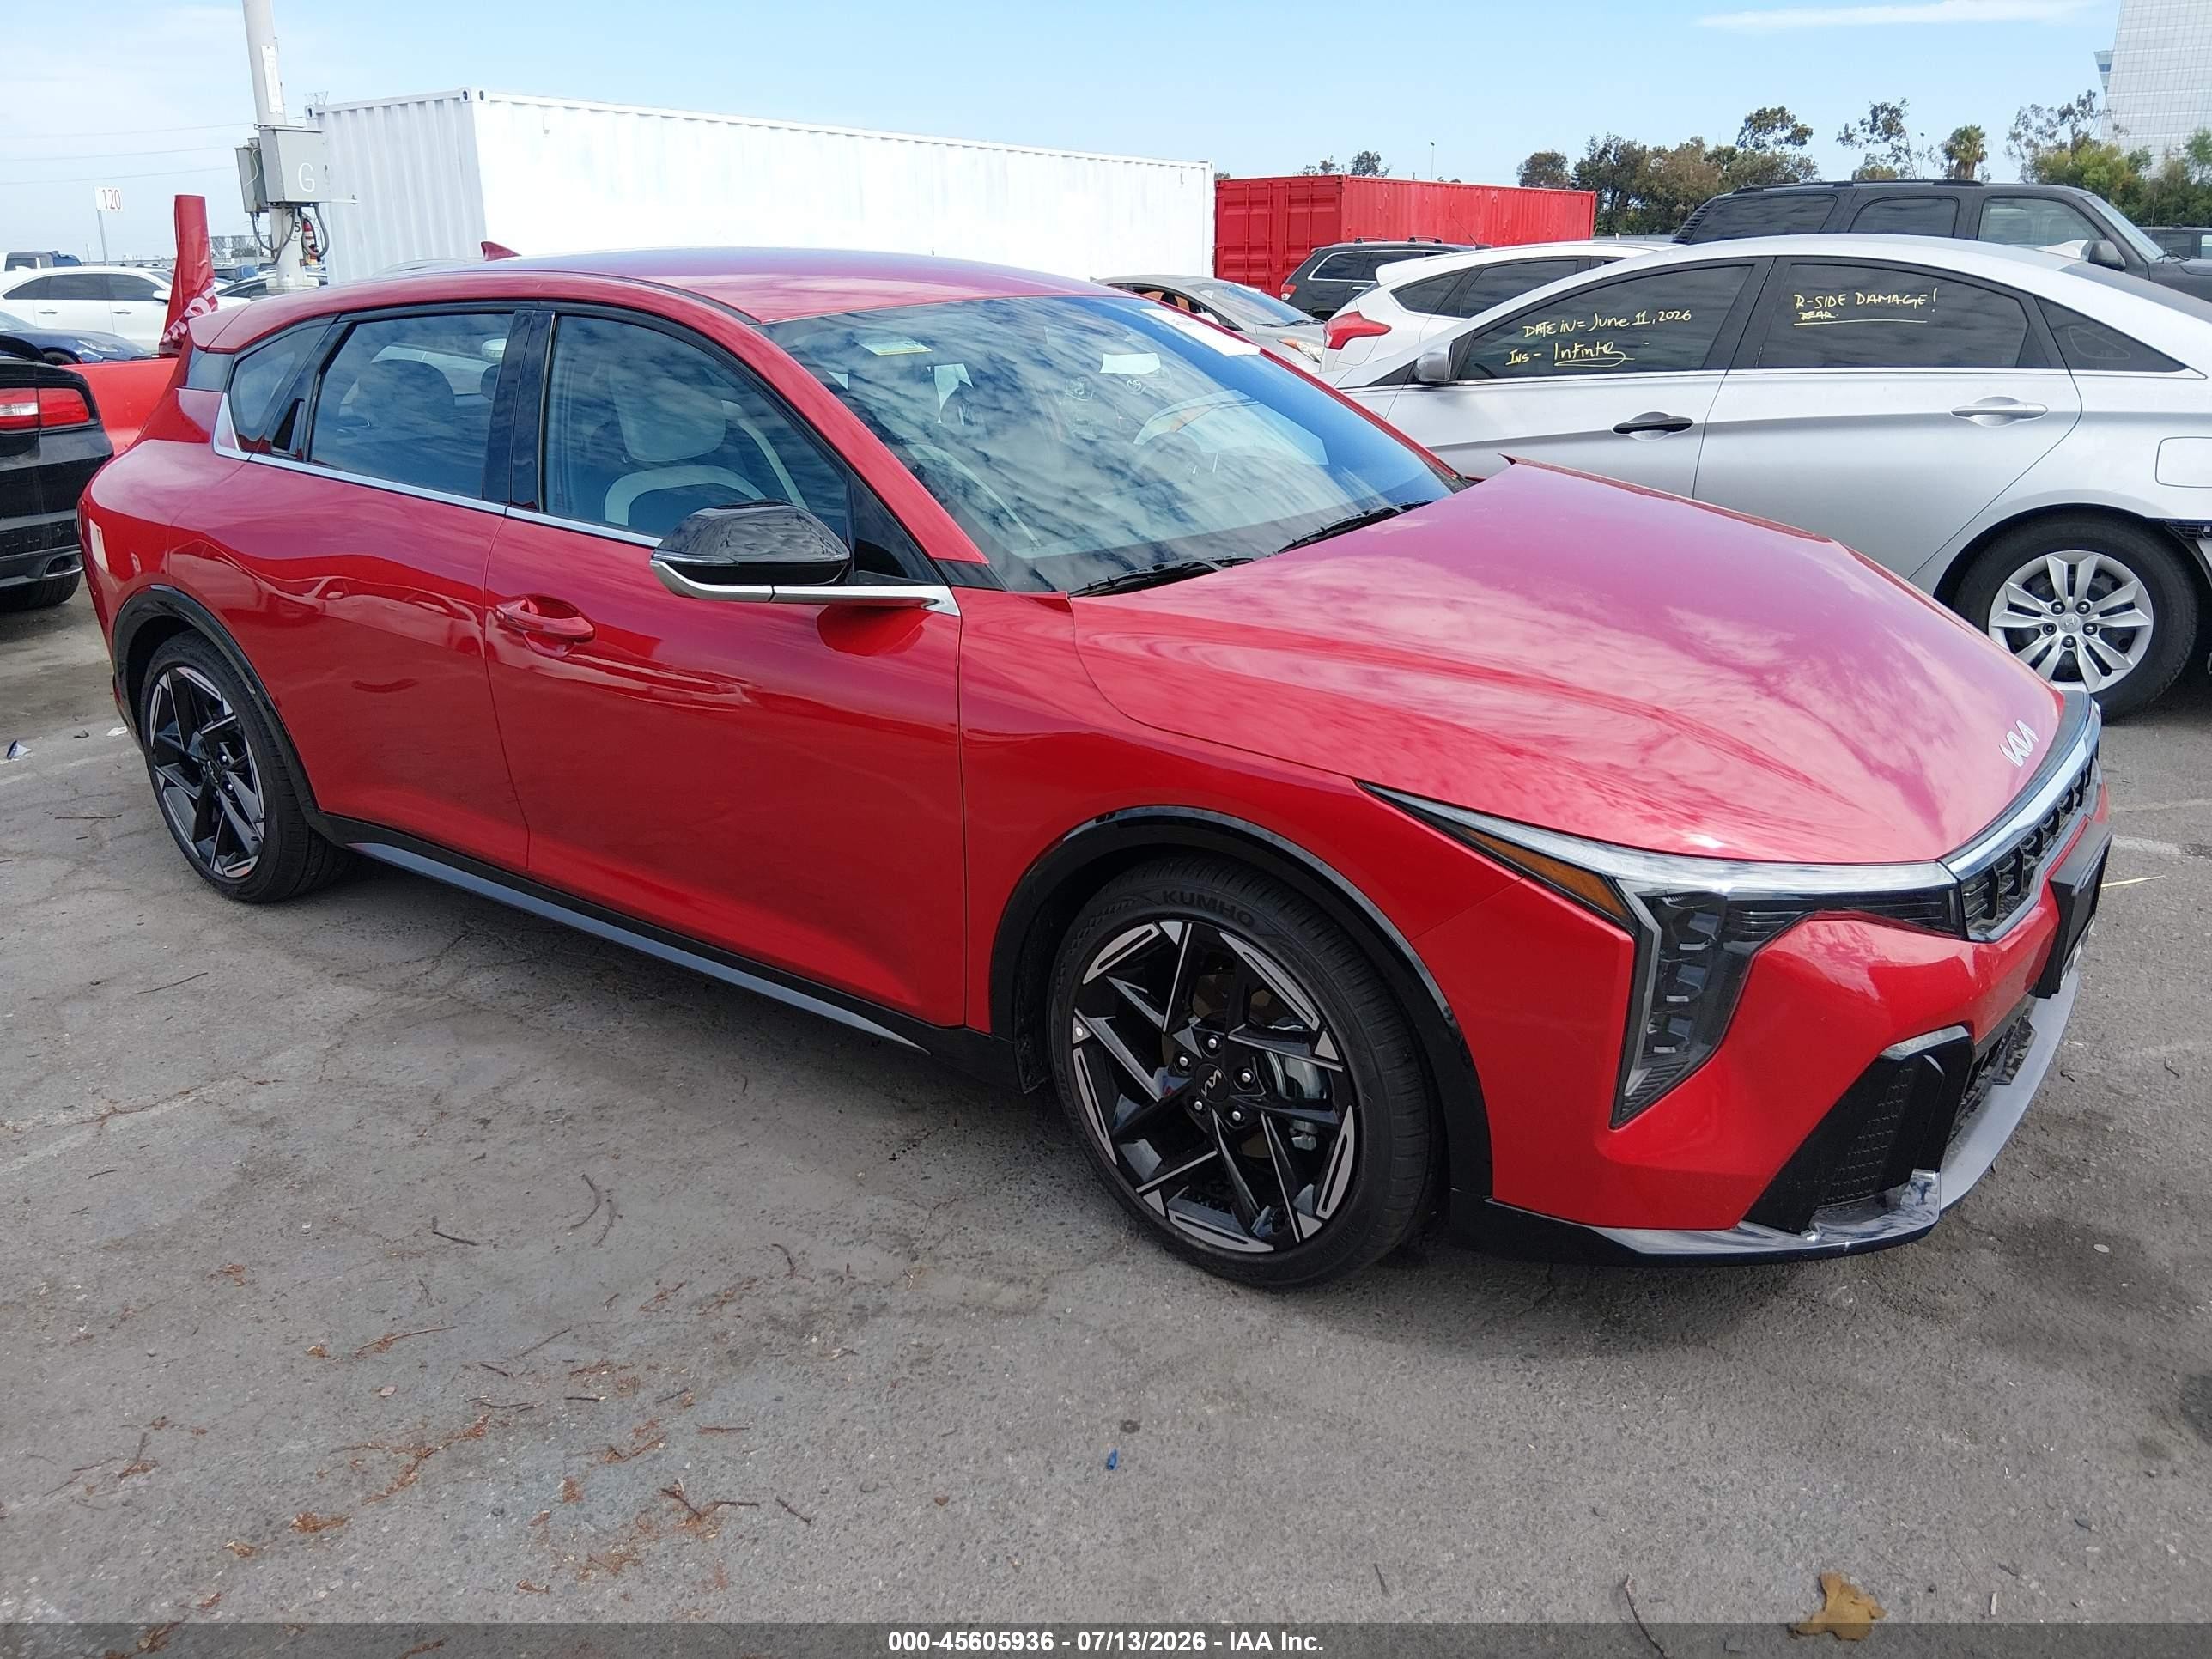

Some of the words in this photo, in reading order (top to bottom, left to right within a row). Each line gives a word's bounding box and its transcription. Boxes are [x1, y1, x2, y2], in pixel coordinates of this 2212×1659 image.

[297, 162, 316, 193] G
[102, 189, 122, 210] 120
[1522, 321, 1557, 337] DATE
[1586, 313, 1630, 332] June
[1162, 890, 1256, 927] KUMHO
